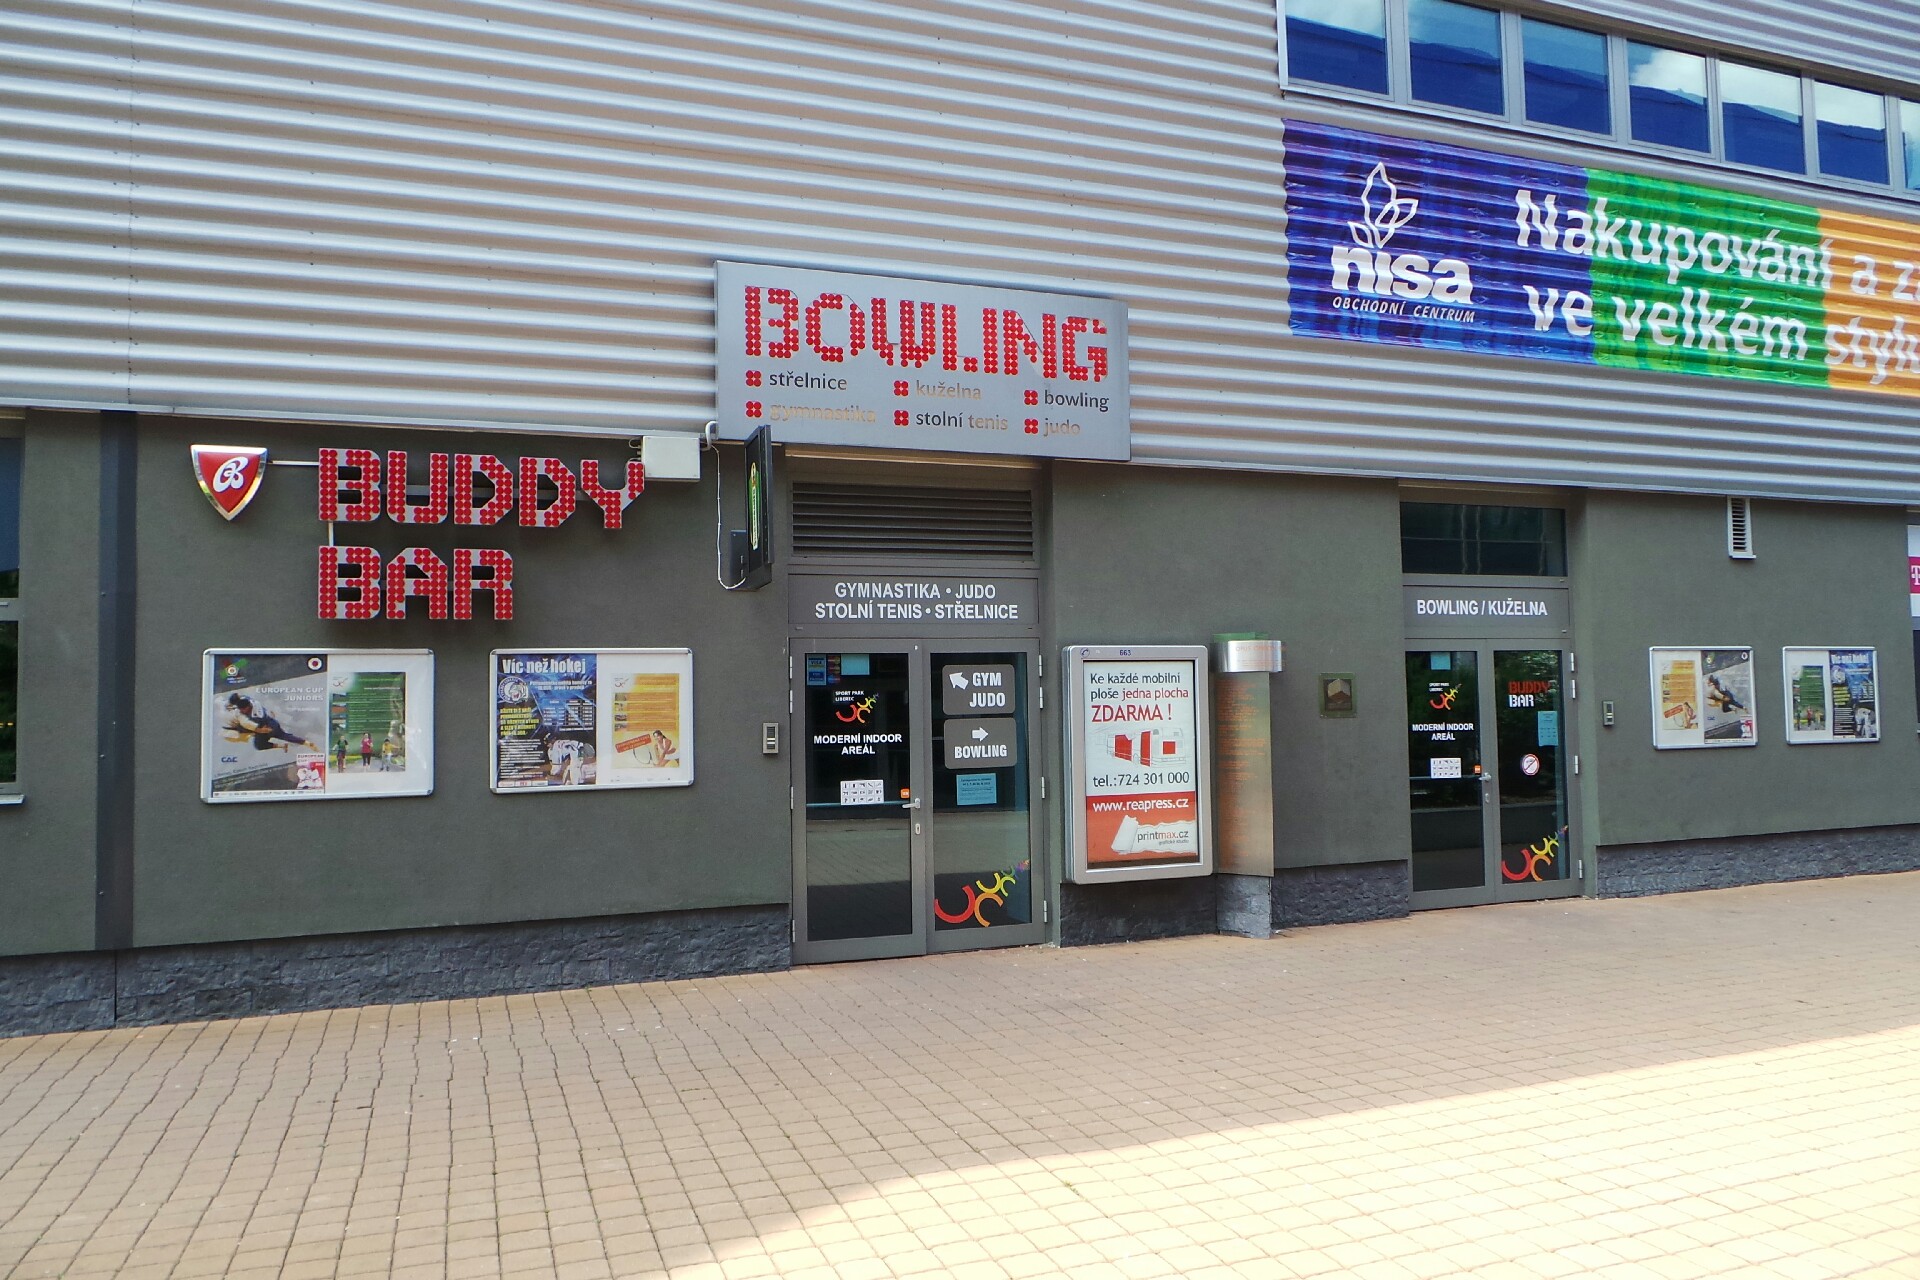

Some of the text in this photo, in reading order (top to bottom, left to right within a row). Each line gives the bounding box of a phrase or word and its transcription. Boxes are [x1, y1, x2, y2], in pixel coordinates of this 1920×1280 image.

[1516, 189, 1920, 300] Nakupování a z
[1331, 245, 1474, 304] nisa
[1332, 296, 1475, 324] OBCHODNÍ CENTRUM
[1522, 284, 1594, 338] ve
[1611, 285, 1808, 361] velkém
[744, 285, 1109, 382] BOWLING
[769, 370, 848, 392] střelnice
[916, 379, 982, 401] kuželna
[1044, 388, 1109, 412] bowling
[769, 403, 877, 424] gymnastika
[916, 408, 1008, 431] stolní tenis
[1043, 418, 1081, 437] judo
[318, 447, 645, 529] BUDDY
[318, 546, 513, 620] BAR
[834, 582, 996, 600] GYMNASTIKA JUDO
[815, 600, 1018, 619] STOLNÍ TENIS STŘELNICE
[1416, 599, 1478, 615] BOWLING
[1488, 598, 1548, 616] KUŽELNA
[502, 658, 586, 674] Víc než hokej
[972, 672, 1002, 687] GYM
[1090, 672, 1181, 684] Ke každé mobilní
[1091, 687, 1189, 702] ploše jedna plocha
[1508, 681, 1551, 694] BUDDY
[969, 692, 1006, 707] JUDO
[1509, 695, 1534, 707] BAR
[1091, 704, 1163, 722] ZDARMA
[1412, 722, 1474, 732] MODERNÍ INDOOR
[1431, 731, 1456, 740] AREÁL
[813, 732, 902, 745] MODERNÍ INDOOR
[841, 743, 876, 755] AREÁL
[954, 744, 1007, 759] BOWLING
[1144, 773, 1163, 785] 301
[1168, 772, 1189, 783] 000
[1093, 798, 1189, 812] www.reapress.cz
[1137, 831, 1189, 843] printmax.cz
